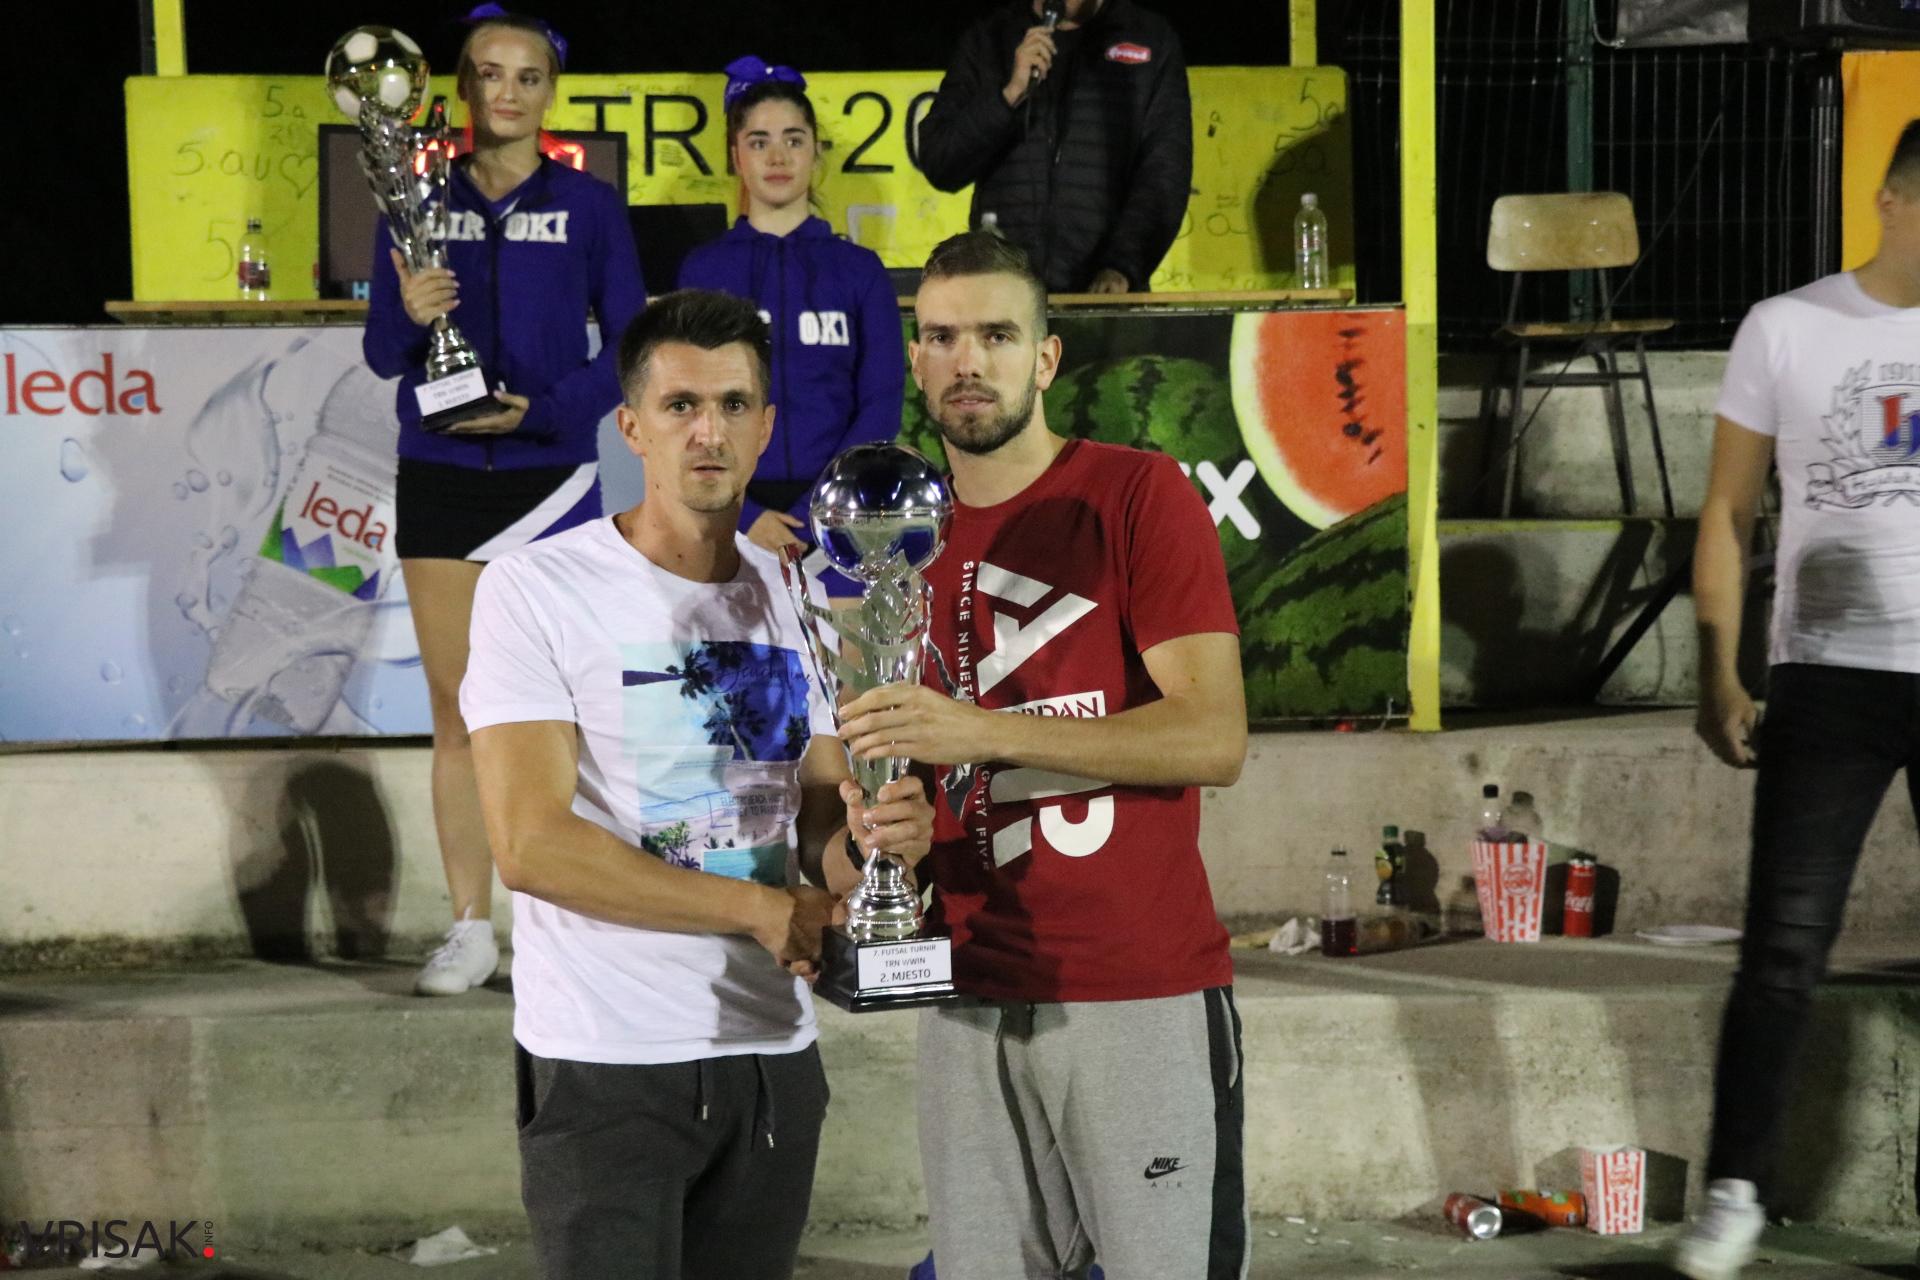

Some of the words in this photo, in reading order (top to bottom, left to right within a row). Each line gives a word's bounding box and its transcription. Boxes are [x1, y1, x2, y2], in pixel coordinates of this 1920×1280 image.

[4, 352, 163, 416] leda
[300, 481, 388, 553] leda
[959, 560, 974, 621] SINCE
[881, 947, 907, 956] FUTSAL
[910, 944, 937, 953] TURNIR
[892, 969, 931, 981] MJESTO
[1151, 1157, 1180, 1170] NIKE
